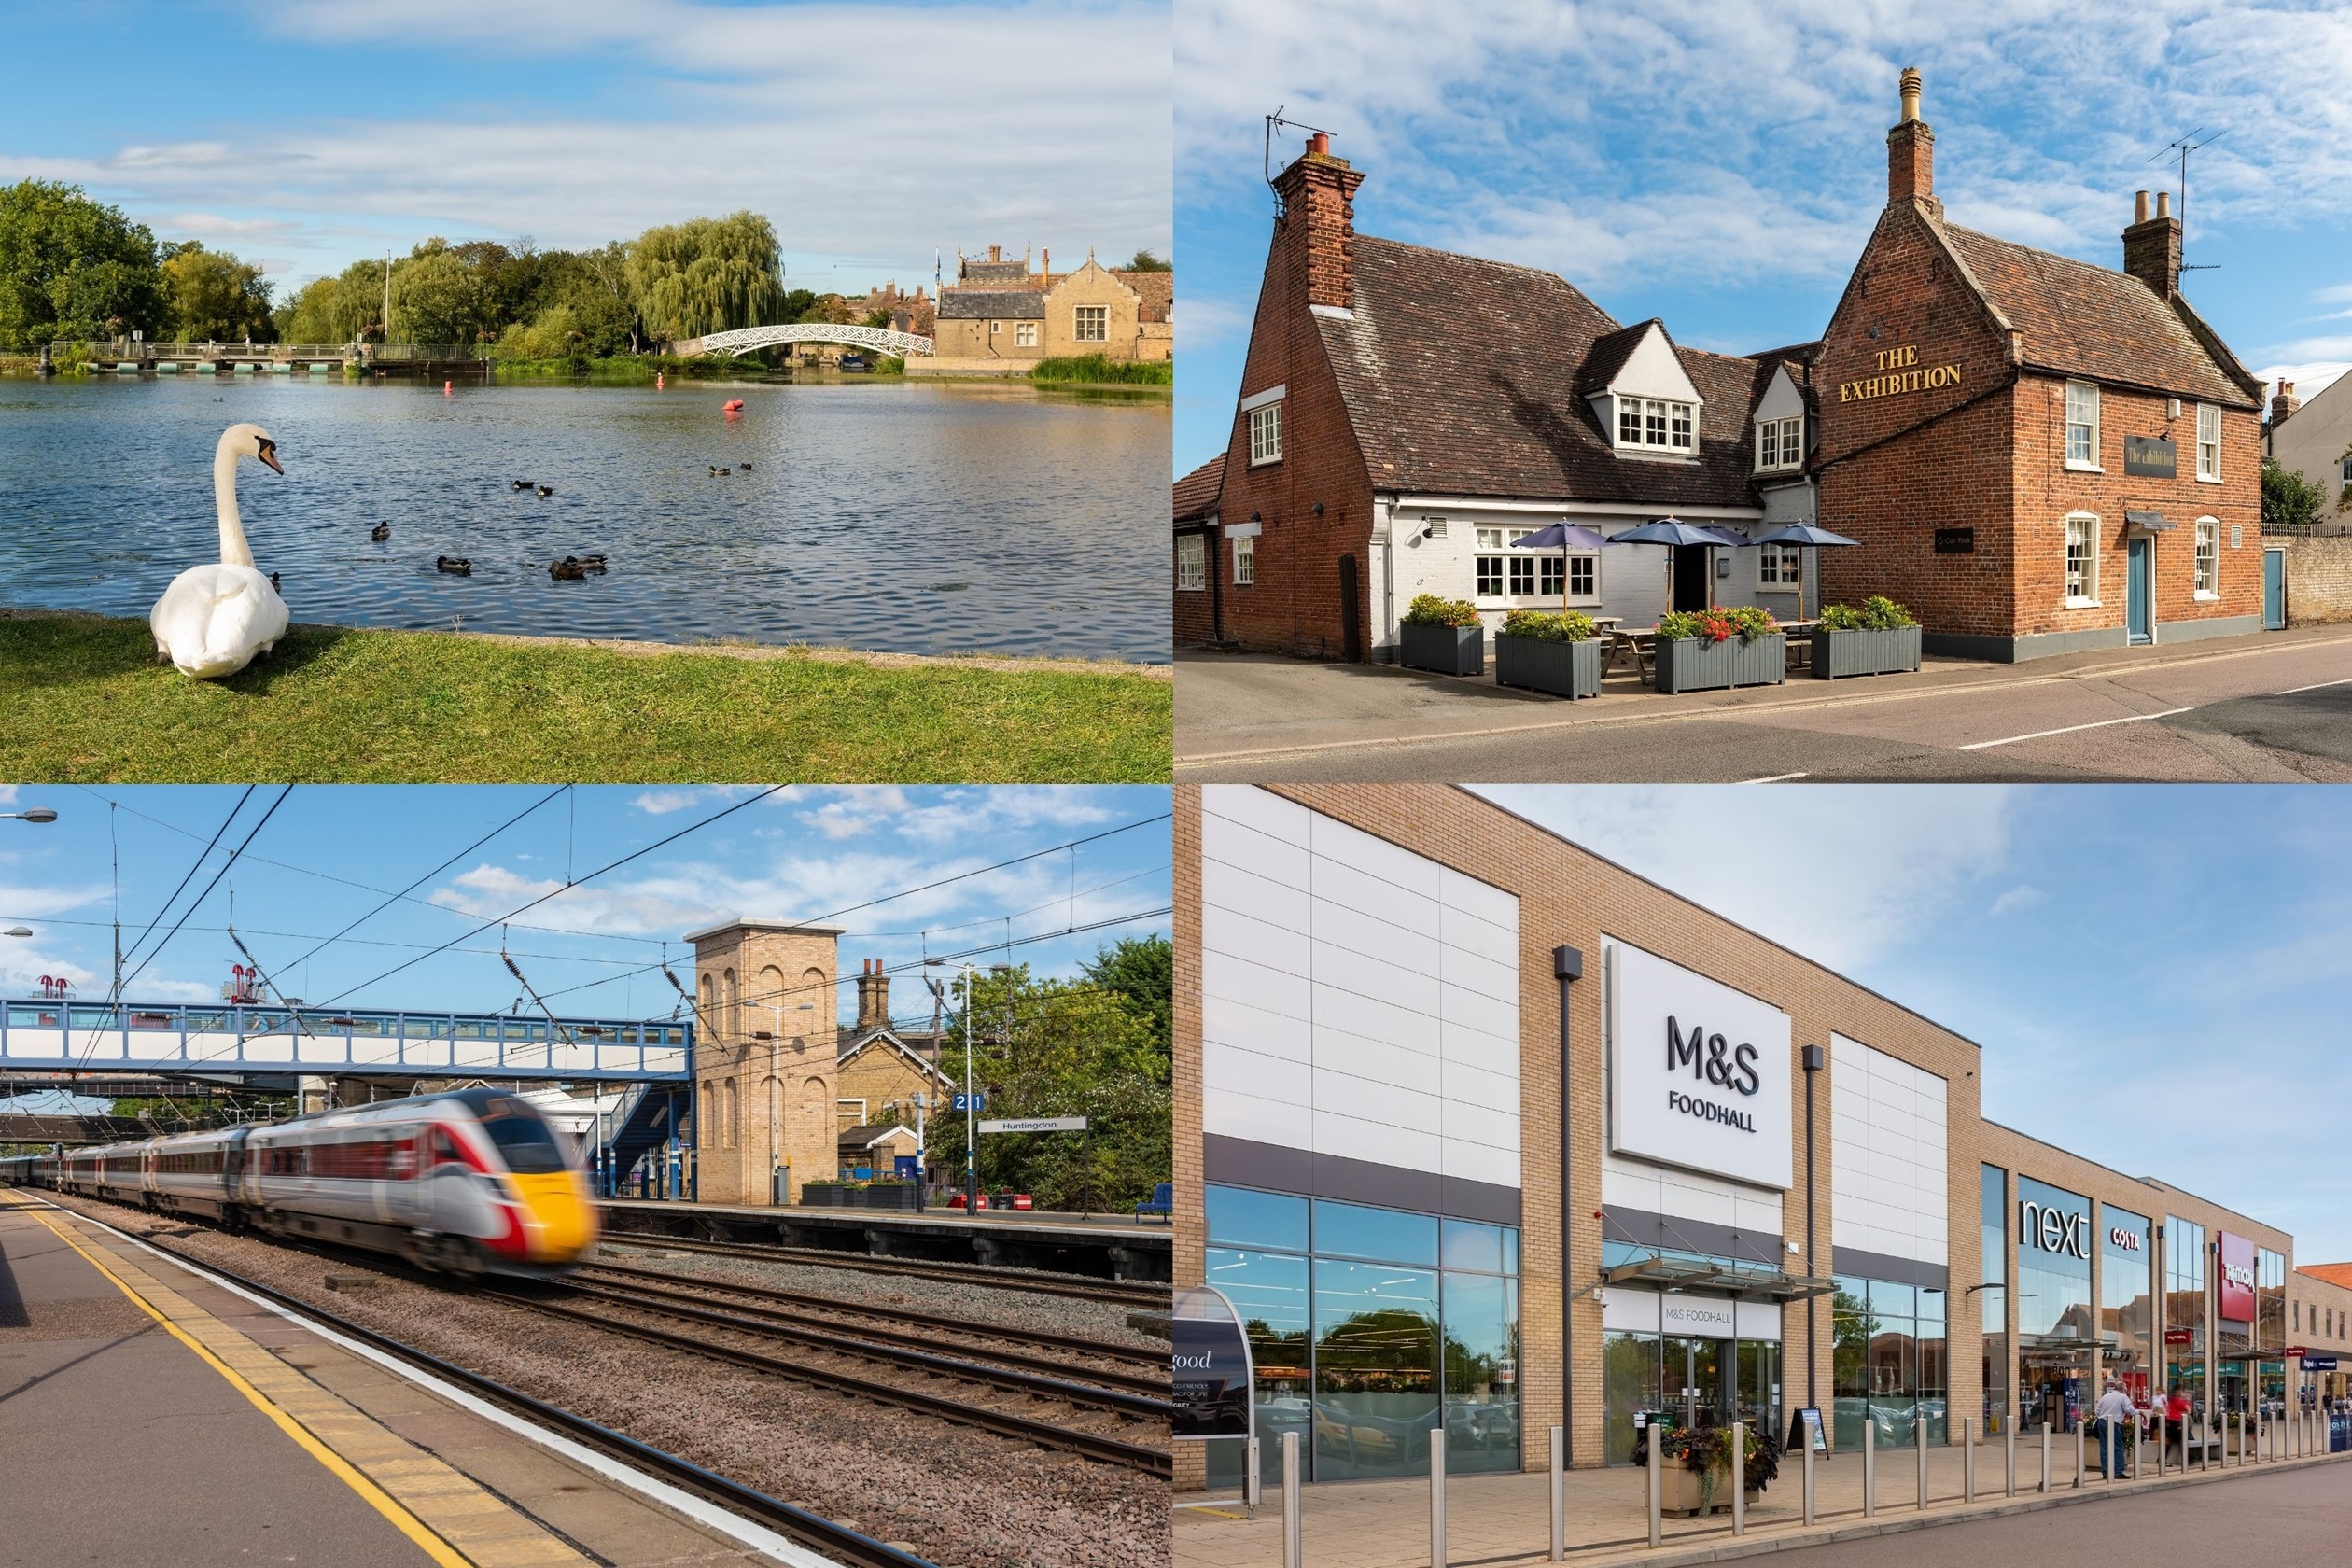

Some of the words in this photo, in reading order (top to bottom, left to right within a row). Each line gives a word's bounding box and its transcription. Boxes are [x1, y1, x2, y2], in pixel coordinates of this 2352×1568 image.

[1876, 345, 1919, 371] THE
[1840, 364, 1962, 403] EXHIBITION
[1957, 536, 1971, 544] Park
[1667, 1015, 1760, 1096] M&S
[956, 1096, 965, 1109] 2
[1669, 1090, 1757, 1133] FOODHALL
[1002, 1121, 1057, 1131] Huntingdon
[2019, 1201, 2090, 1259] next
[2111, 1227, 2140, 1250] COSTA
[1666, 1309, 1684, 1320] M&S
[1687, 1309, 1731, 1323] FOODHALL
